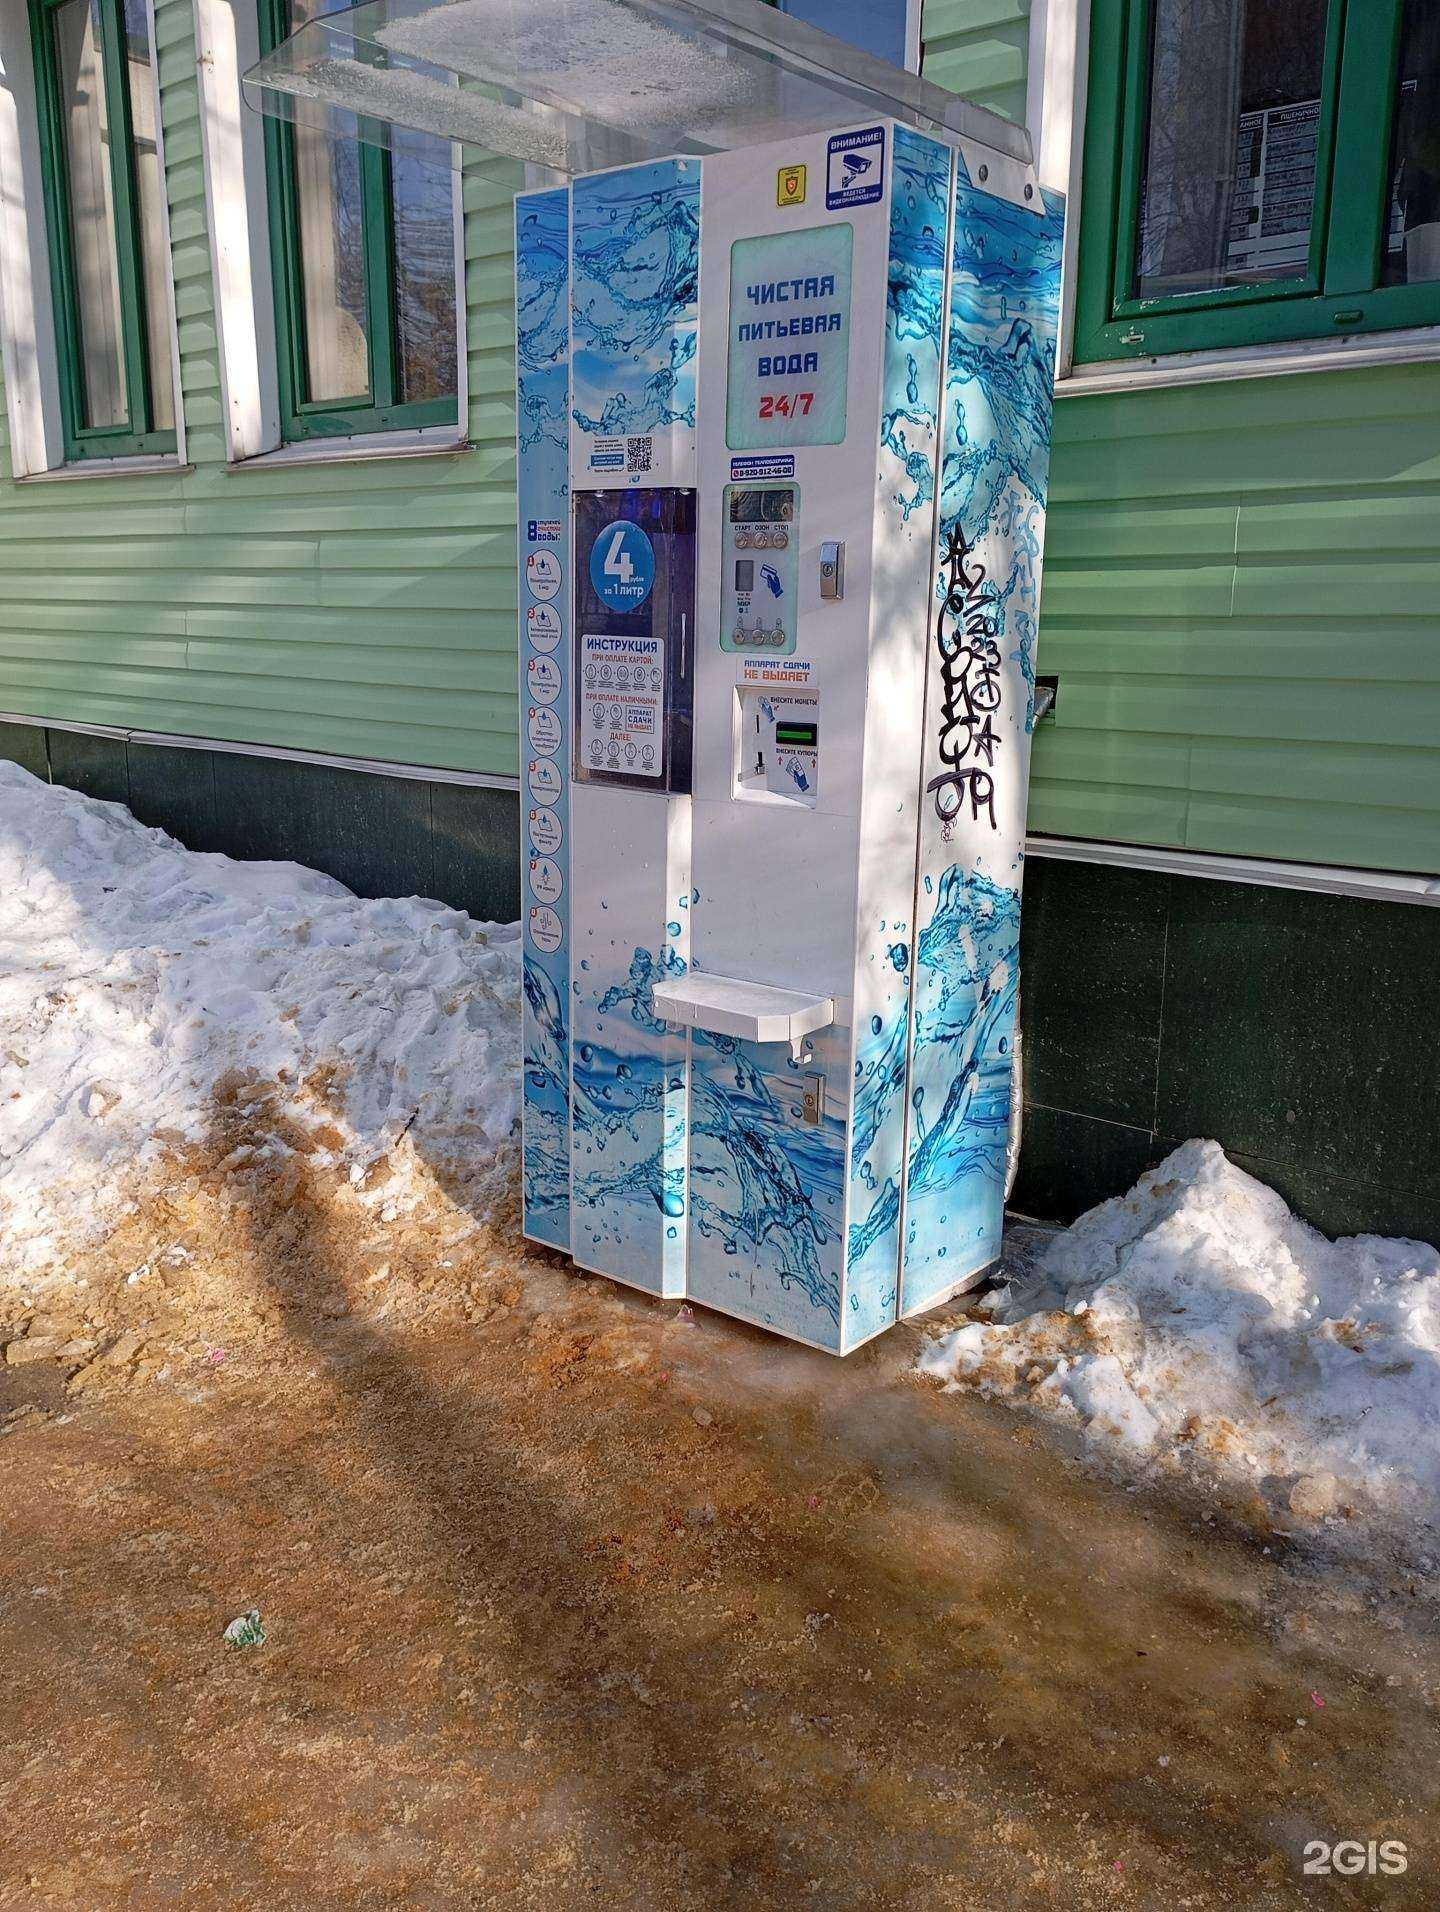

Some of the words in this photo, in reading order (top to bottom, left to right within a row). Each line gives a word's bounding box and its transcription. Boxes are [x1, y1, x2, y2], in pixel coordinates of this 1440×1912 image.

[831, 132, 882, 150] ВНИМАНИЕ!
[747, 275, 835, 305] ЧИСТАЯ
[738, 313, 842, 342] ПИТЬЕВАЯ
[758, 352, 818, 377] ВОДА
[759, 393, 815, 418] 24/7
[528, 520, 537, 541] 8
[604, 531, 634, 583] 4
[613, 584, 618, 595] 1
[620, 586, 644, 598] литр
[587, 638, 658, 654] ИНСТРУКЦИЯ
[592, 653, 604, 661] ПРИ
[605, 654, 628, 663] ОПЛАТЕ
[744, 660, 780, 669] АППАРАТ
[783, 661, 810, 670] СДАЧИ
[744, 670, 758, 679] НЕ
[762, 670, 810, 682] ВЫДАЕТ
[770, 696, 794, 705] ВНЕСИТЕ
[628, 715, 652, 724] СДАЧИ
